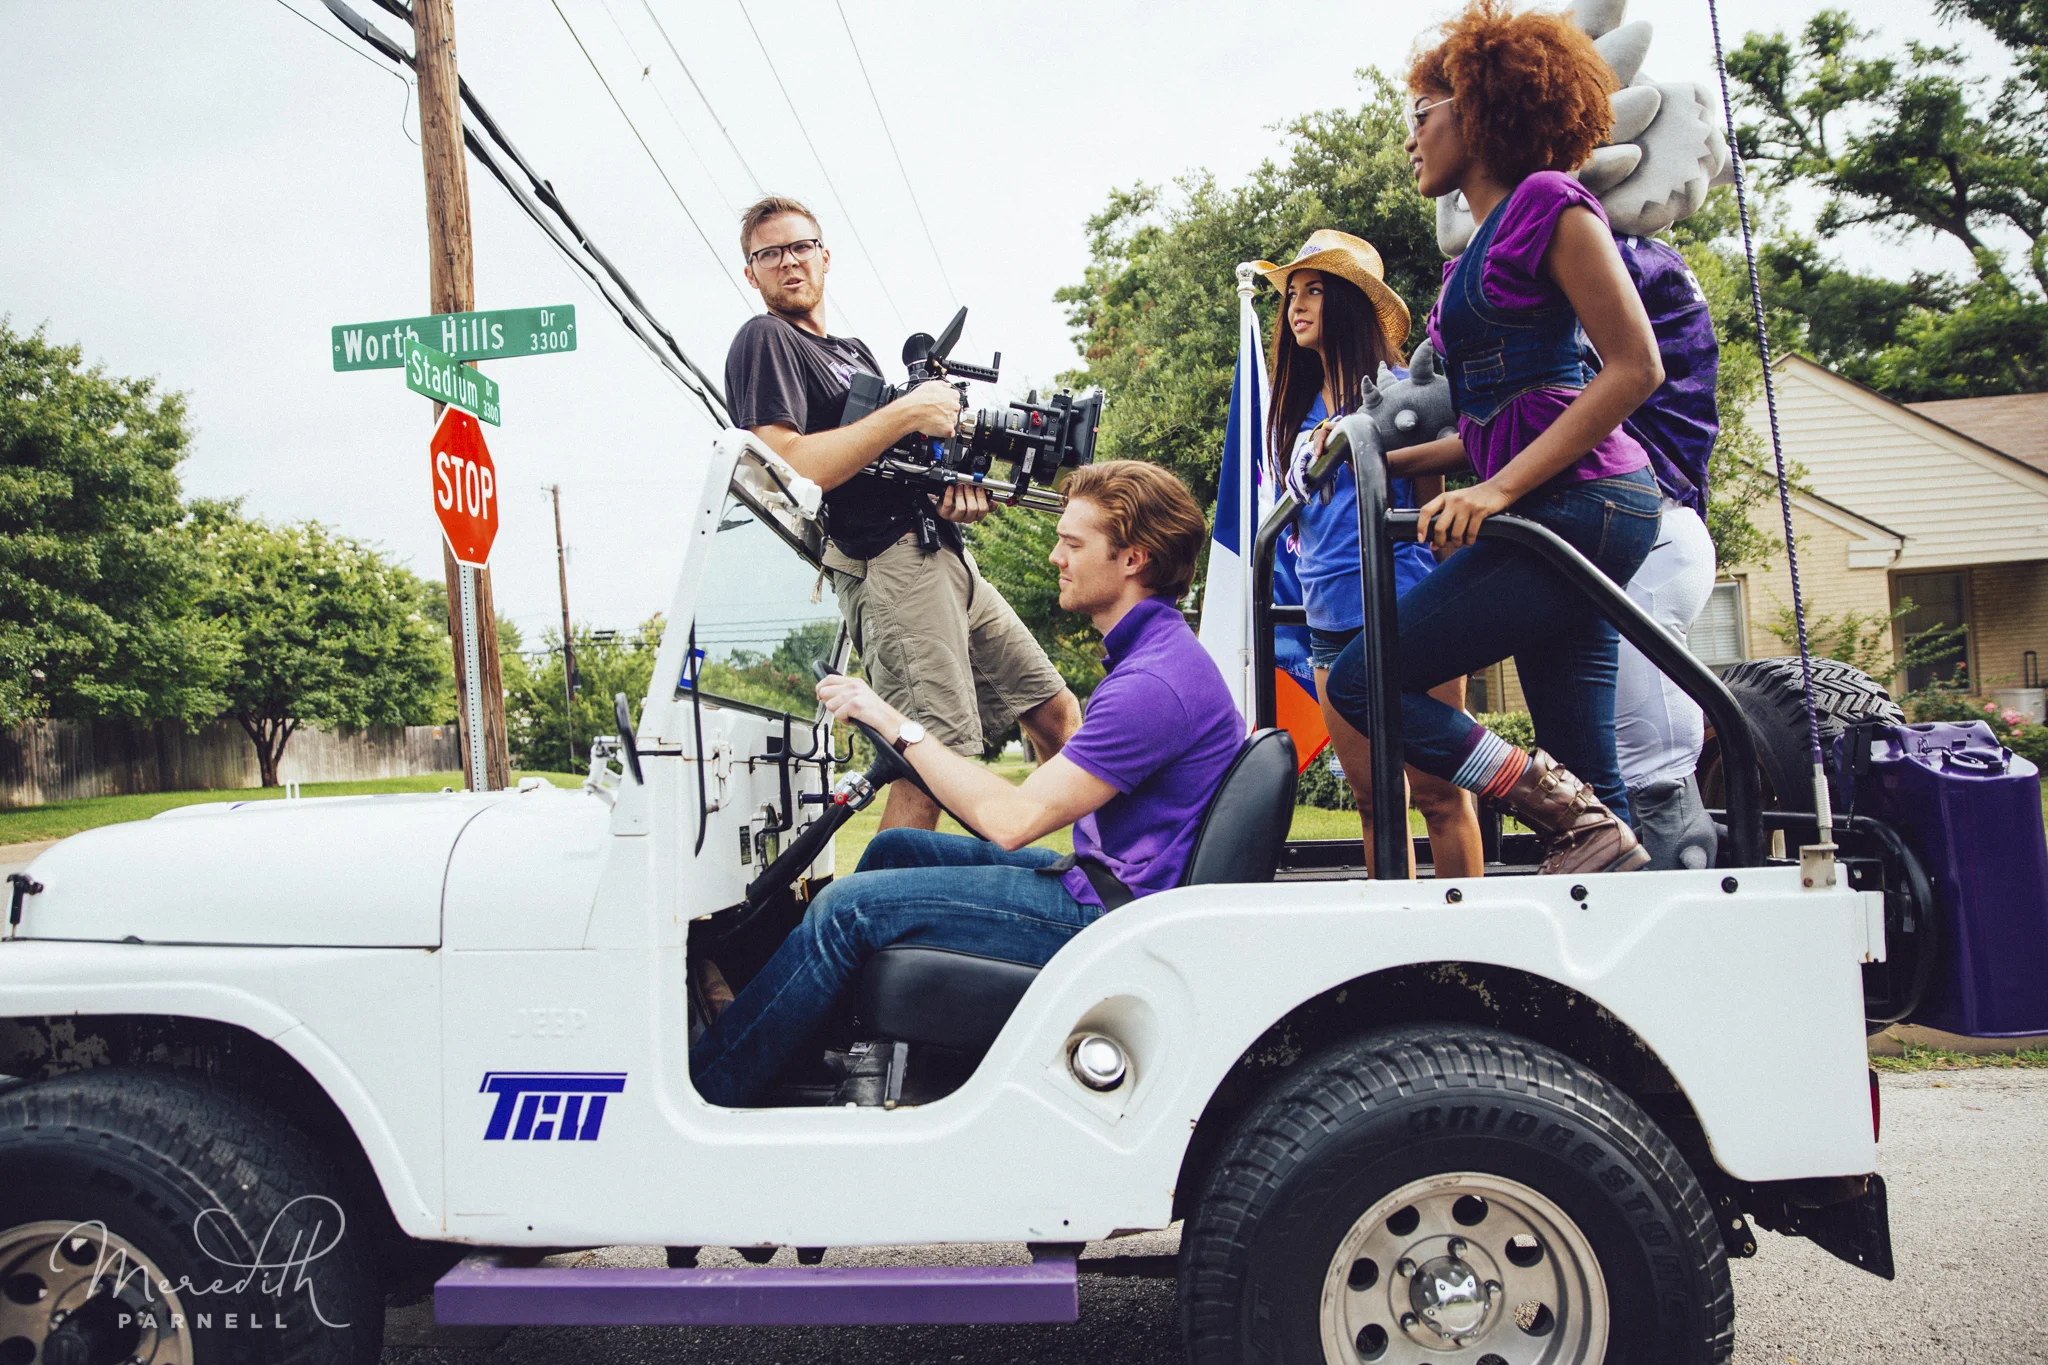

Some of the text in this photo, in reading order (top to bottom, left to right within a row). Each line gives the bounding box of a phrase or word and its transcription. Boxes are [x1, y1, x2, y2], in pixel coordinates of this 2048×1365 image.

[441, 317, 504, 354] Hills
[540, 309, 555, 327] Dr
[530, 330, 568, 351] 3300
[411, 349, 492, 409] Stadium Dr
[483, 400, 499, 423] 3300
[436, 451, 493, 520] STOP
[508, 1007, 588, 1039] JEEP
